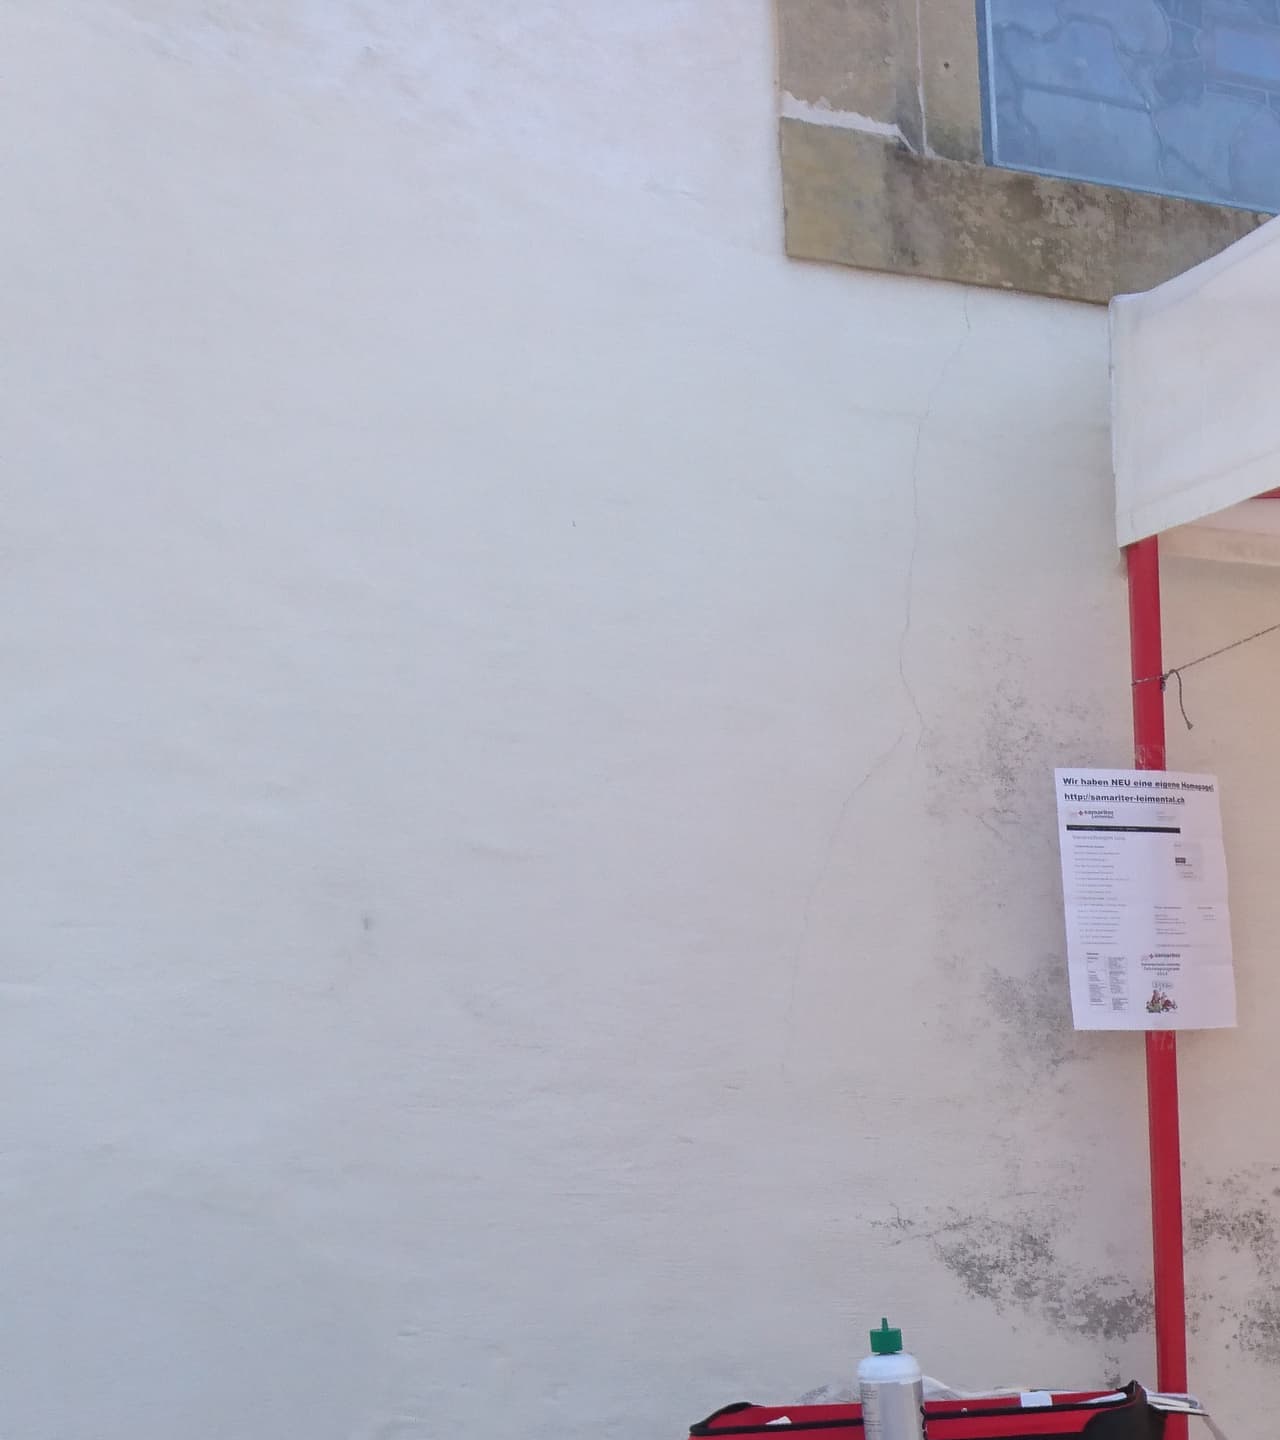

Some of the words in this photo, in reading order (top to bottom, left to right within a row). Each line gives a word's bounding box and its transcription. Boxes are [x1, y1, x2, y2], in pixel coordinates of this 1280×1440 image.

[1062, 777, 1078, 786] Wir
[1080, 778, 1109, 786] haben
[1111, 779, 1131, 787] NEU
[1133, 780, 1153, 788] eine
[1155, 781, 1180, 791] eigene
